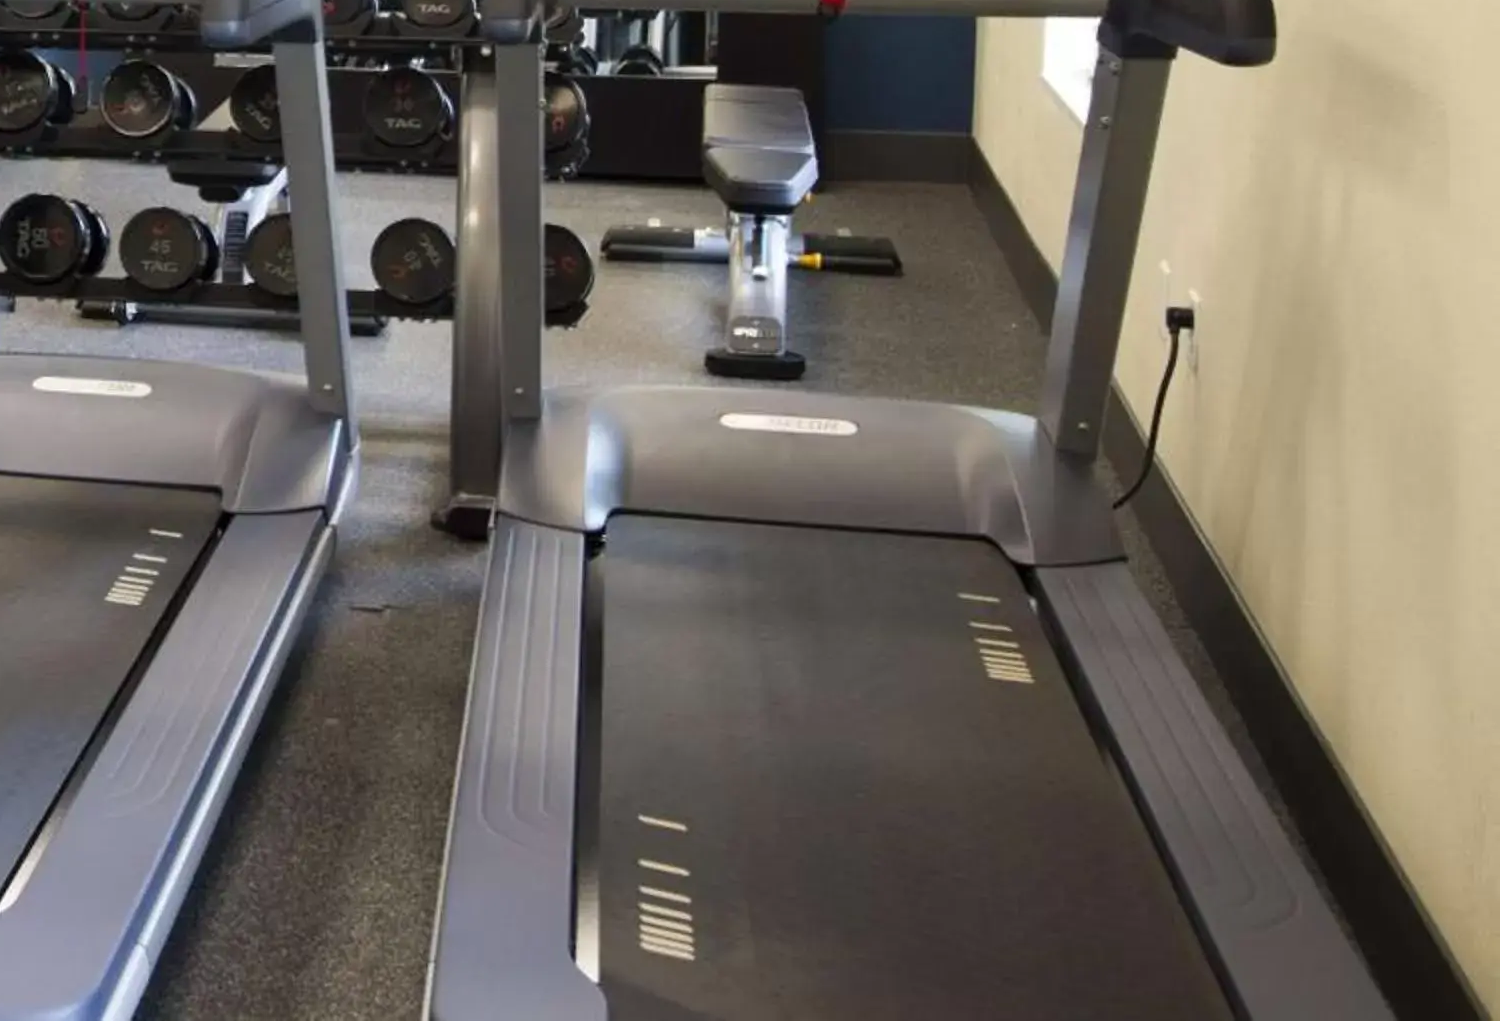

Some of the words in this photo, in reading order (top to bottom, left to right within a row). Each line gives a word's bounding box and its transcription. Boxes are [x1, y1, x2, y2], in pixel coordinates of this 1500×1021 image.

[417, 3, 451, 15] TAG
[384, 117, 422, 129] TAG
[16, 217, 31, 259] TAG
[31, 227, 49, 249] 50
[150, 239, 172, 255] 45
[140, 260, 180, 273] TAG
